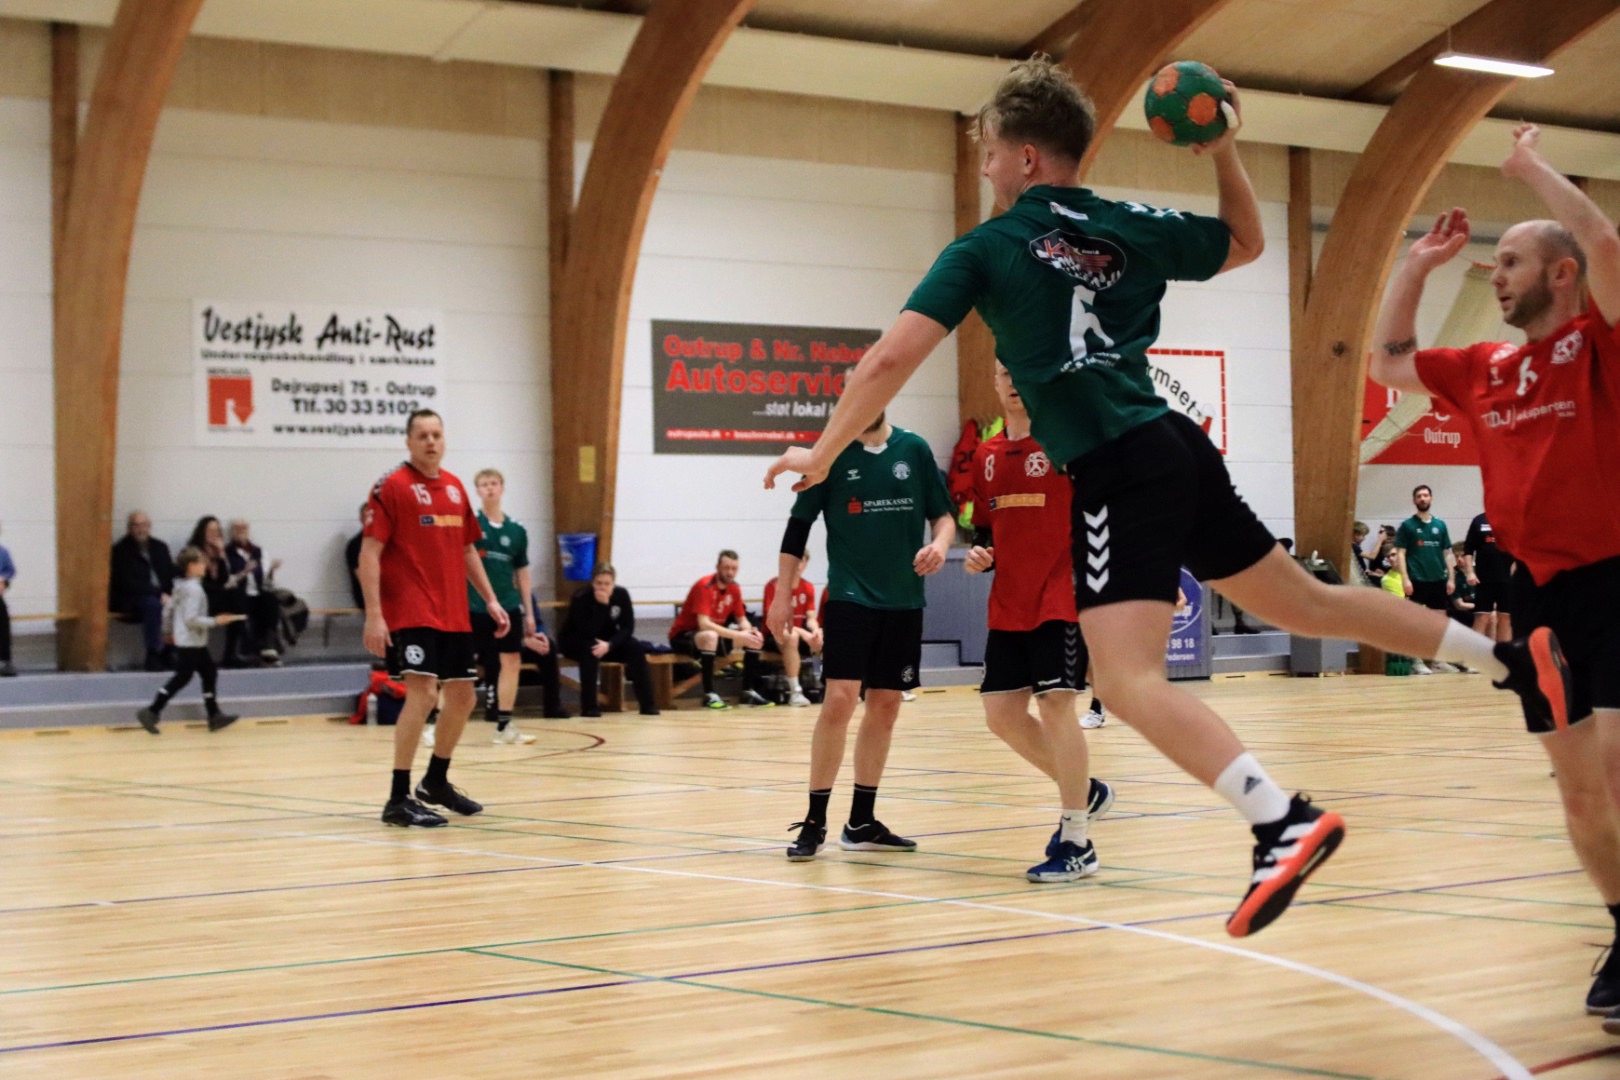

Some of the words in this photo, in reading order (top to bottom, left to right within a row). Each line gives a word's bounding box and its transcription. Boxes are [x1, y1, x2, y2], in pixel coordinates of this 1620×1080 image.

[202, 306, 303, 349] Vestjysk
[316, 312, 436, 351] Anti-Rust
[663, 334, 742, 362] Outrup
[750, 338, 766, 360] &
[773, 340, 804, 361] Nr.
[665, 360, 848, 396] Autoservic
[351, 380, 368, 394] 75
[386, 381, 437, 398] Outrup
[293, 399, 321, 413] Tlf.
[325, 399, 347, 414] 30
[352, 399, 372, 414] 33
[792, 401, 826, 417] lokal
[273, 425, 407, 437] www.vestjysk-antiru
[1424, 428, 1461, 448] Outrup
[984, 454, 995, 482] 8
[410, 483, 432, 505] 15
